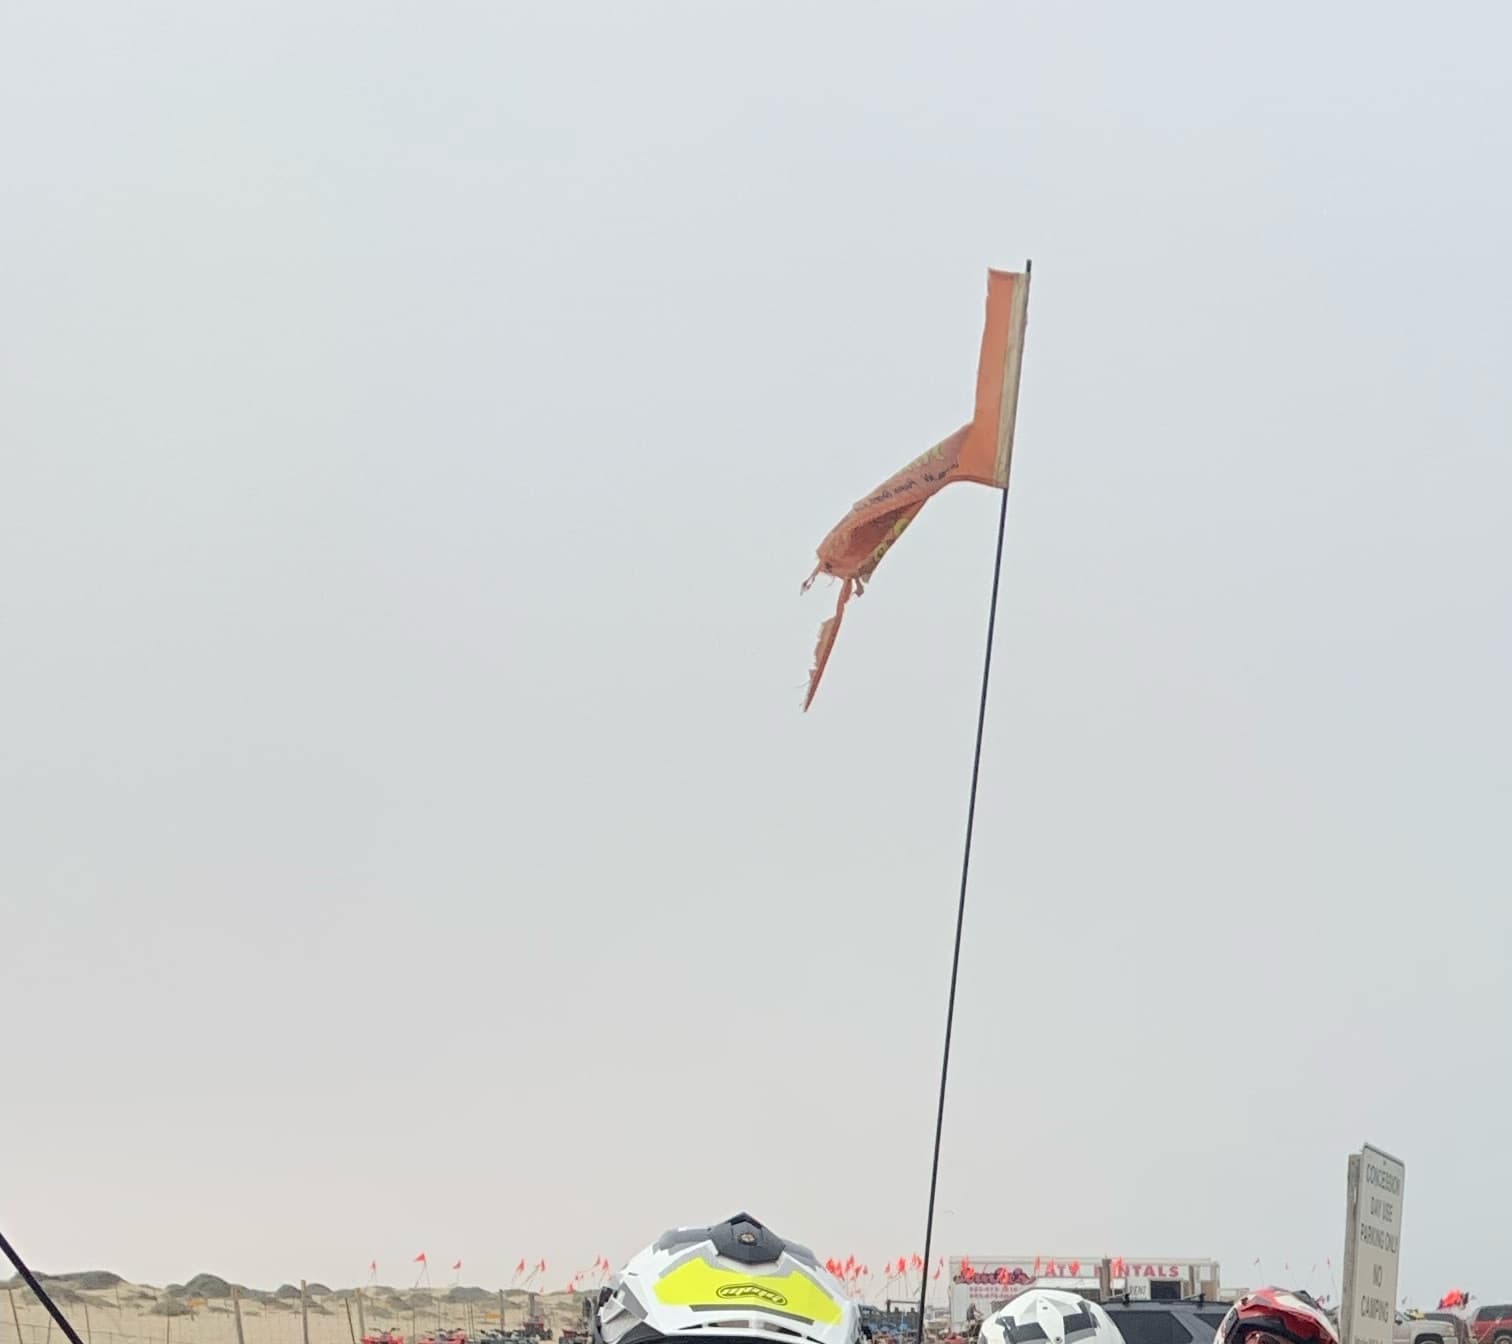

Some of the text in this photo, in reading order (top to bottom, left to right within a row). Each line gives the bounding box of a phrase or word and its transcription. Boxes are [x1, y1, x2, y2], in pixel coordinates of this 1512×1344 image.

[1360, 1223, 1384, 1250] PARKING
[1372, 1264, 1383, 1288] NO
[1360, 1295, 1390, 1323] CAMPING
